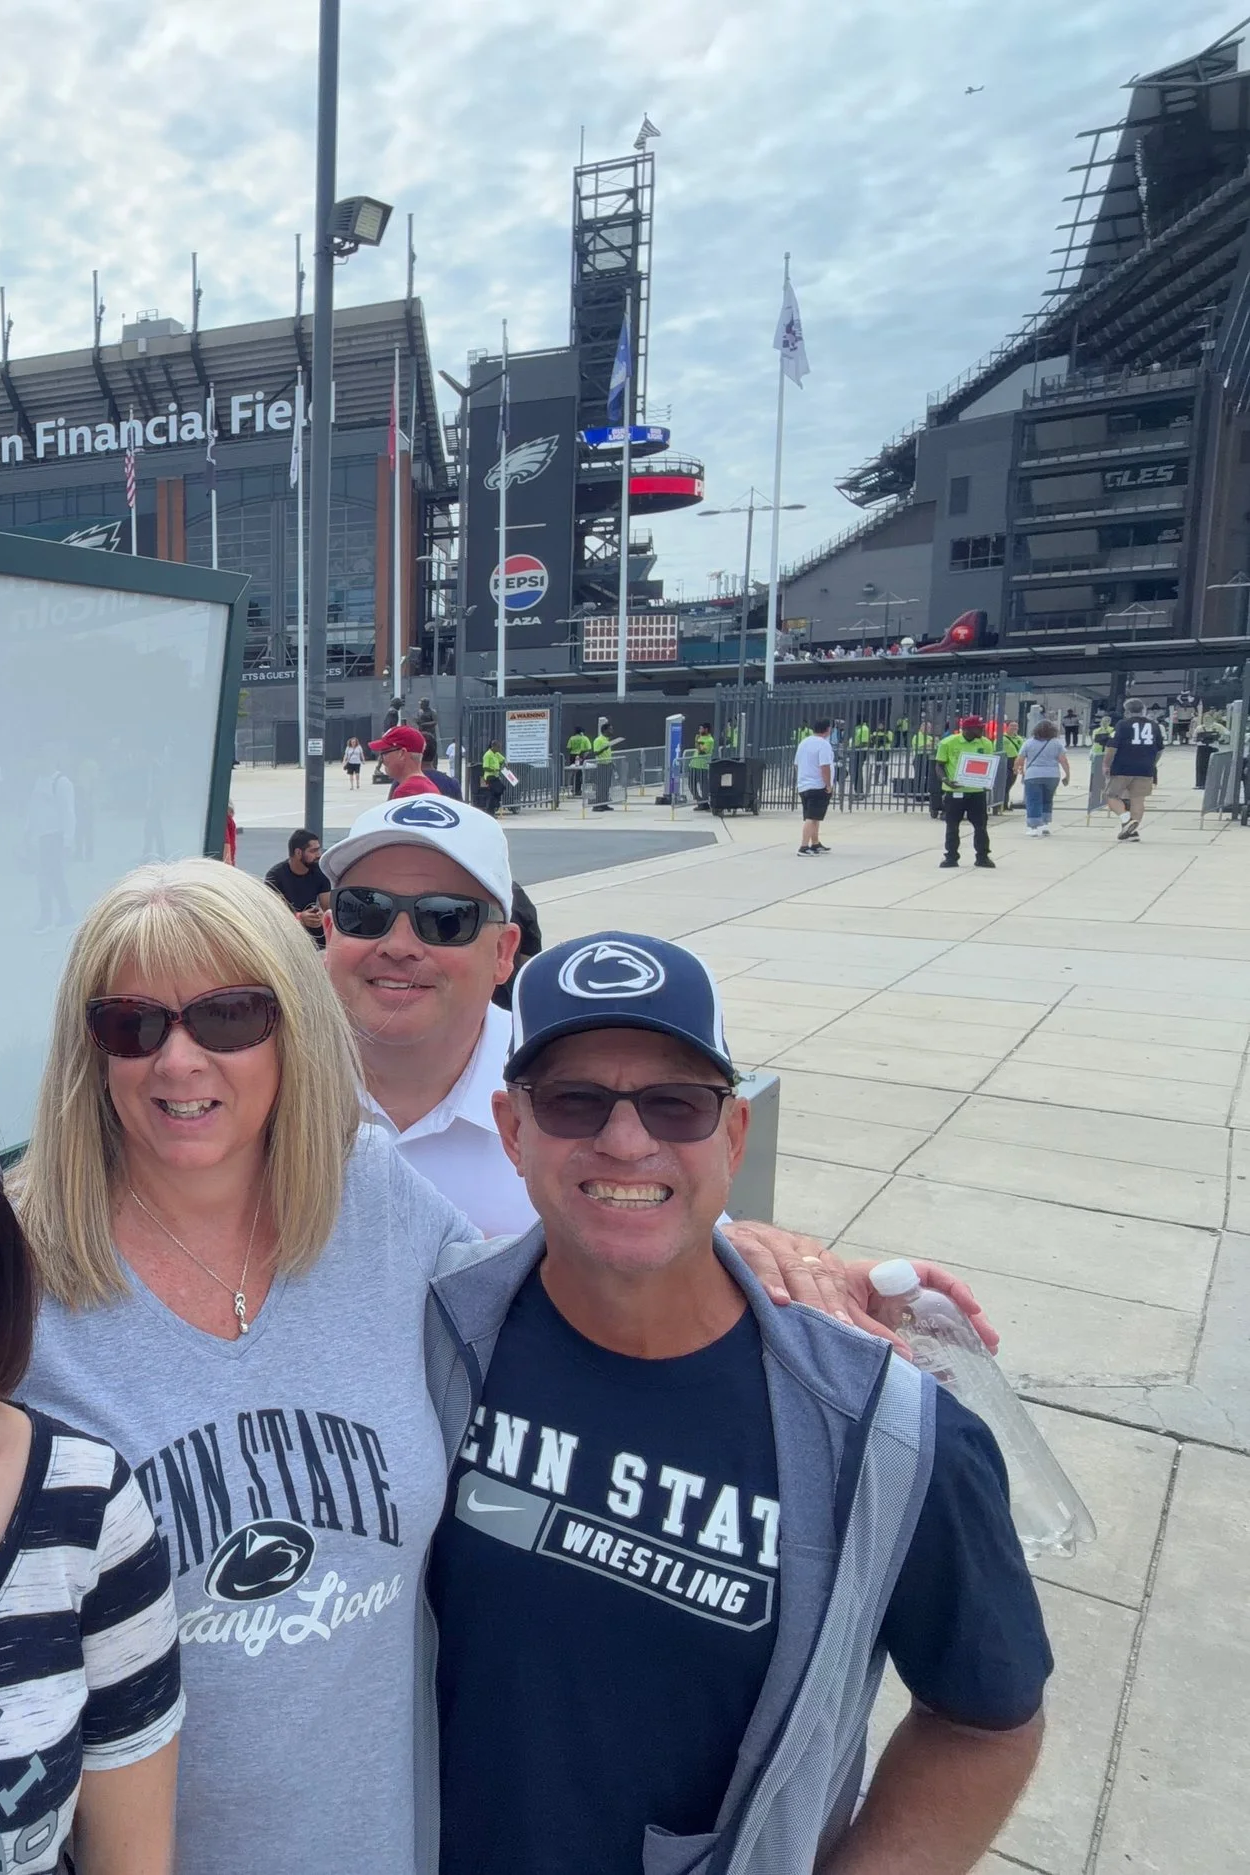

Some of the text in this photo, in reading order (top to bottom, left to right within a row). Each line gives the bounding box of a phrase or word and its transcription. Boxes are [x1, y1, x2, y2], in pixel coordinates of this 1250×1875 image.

[35, 402, 218, 459] Financial
[231, 382, 335, 434] Fie
[1105, 465, 1175, 488] GLES
[1131, 722, 1154, 745] 14
[134, 1408, 403, 1578] ENN STATE
[460, 1405, 781, 1569] ENN STAT
[561, 1520, 751, 1614] WRESTLING
